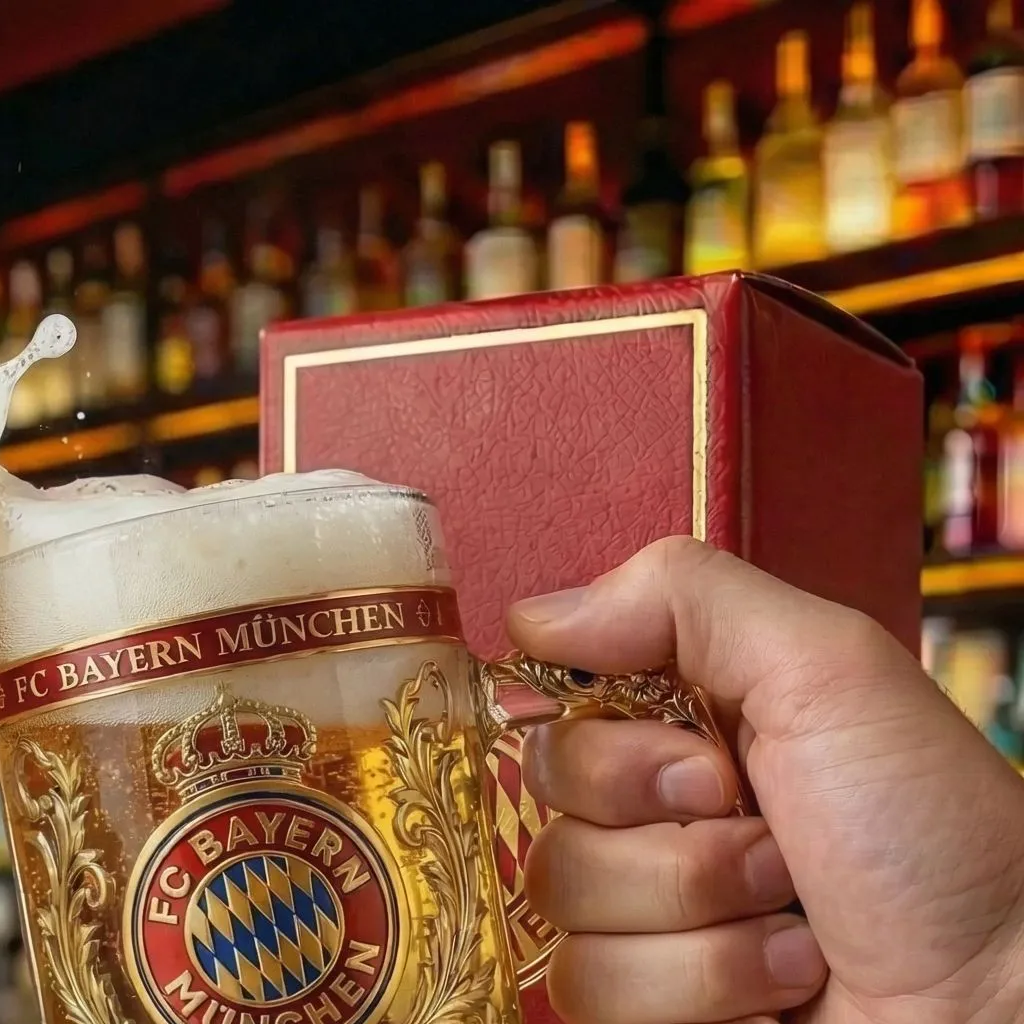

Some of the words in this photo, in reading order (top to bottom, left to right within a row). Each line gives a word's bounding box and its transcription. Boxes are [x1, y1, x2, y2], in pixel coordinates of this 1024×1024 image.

[16, 668, 50, 703] FC
[59, 632, 203, 691] BAYERN
[216, 602, 408, 656] MÜNCHEN
[148, 866, 191, 925] FC
[187, 811, 372, 894] BAYERN
